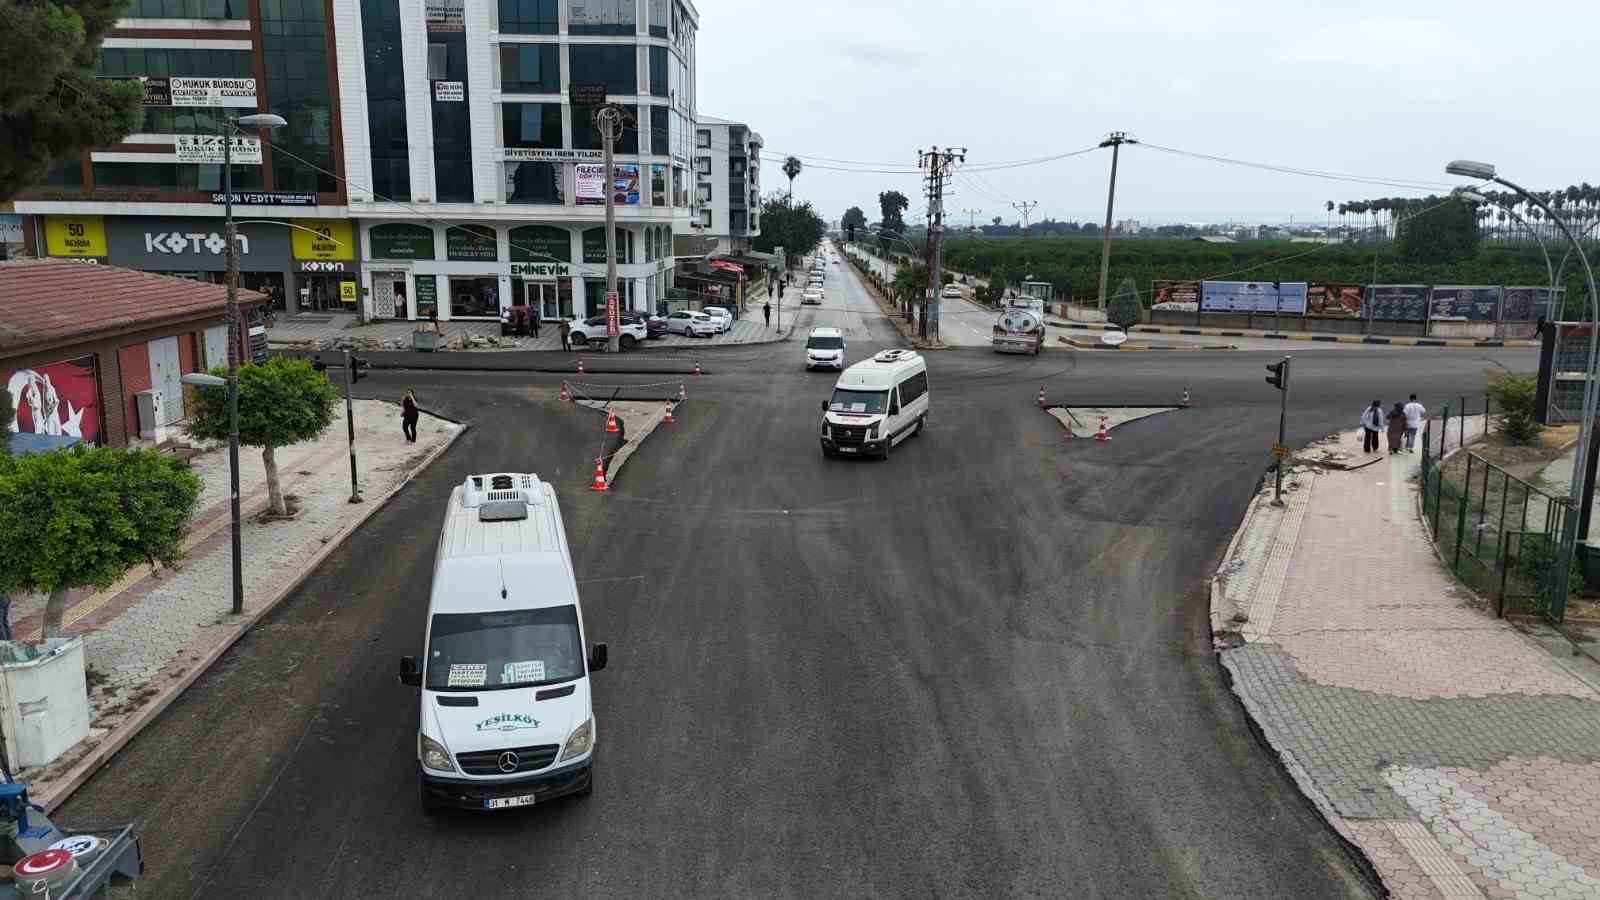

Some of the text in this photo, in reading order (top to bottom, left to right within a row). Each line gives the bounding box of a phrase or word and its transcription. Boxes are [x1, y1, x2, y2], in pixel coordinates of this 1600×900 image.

[182, 80, 210, 89] HUKUK
[180, 145, 260, 153] HUKUK BROSU
[212, 194, 241, 202] SAON
[145, 232, 249, 254] KOTON
[302, 262, 344, 271] KOTON
[510, 262, 569, 275] EMİNEVİM
[476, 712, 541, 731] YEŞİLKÖY
